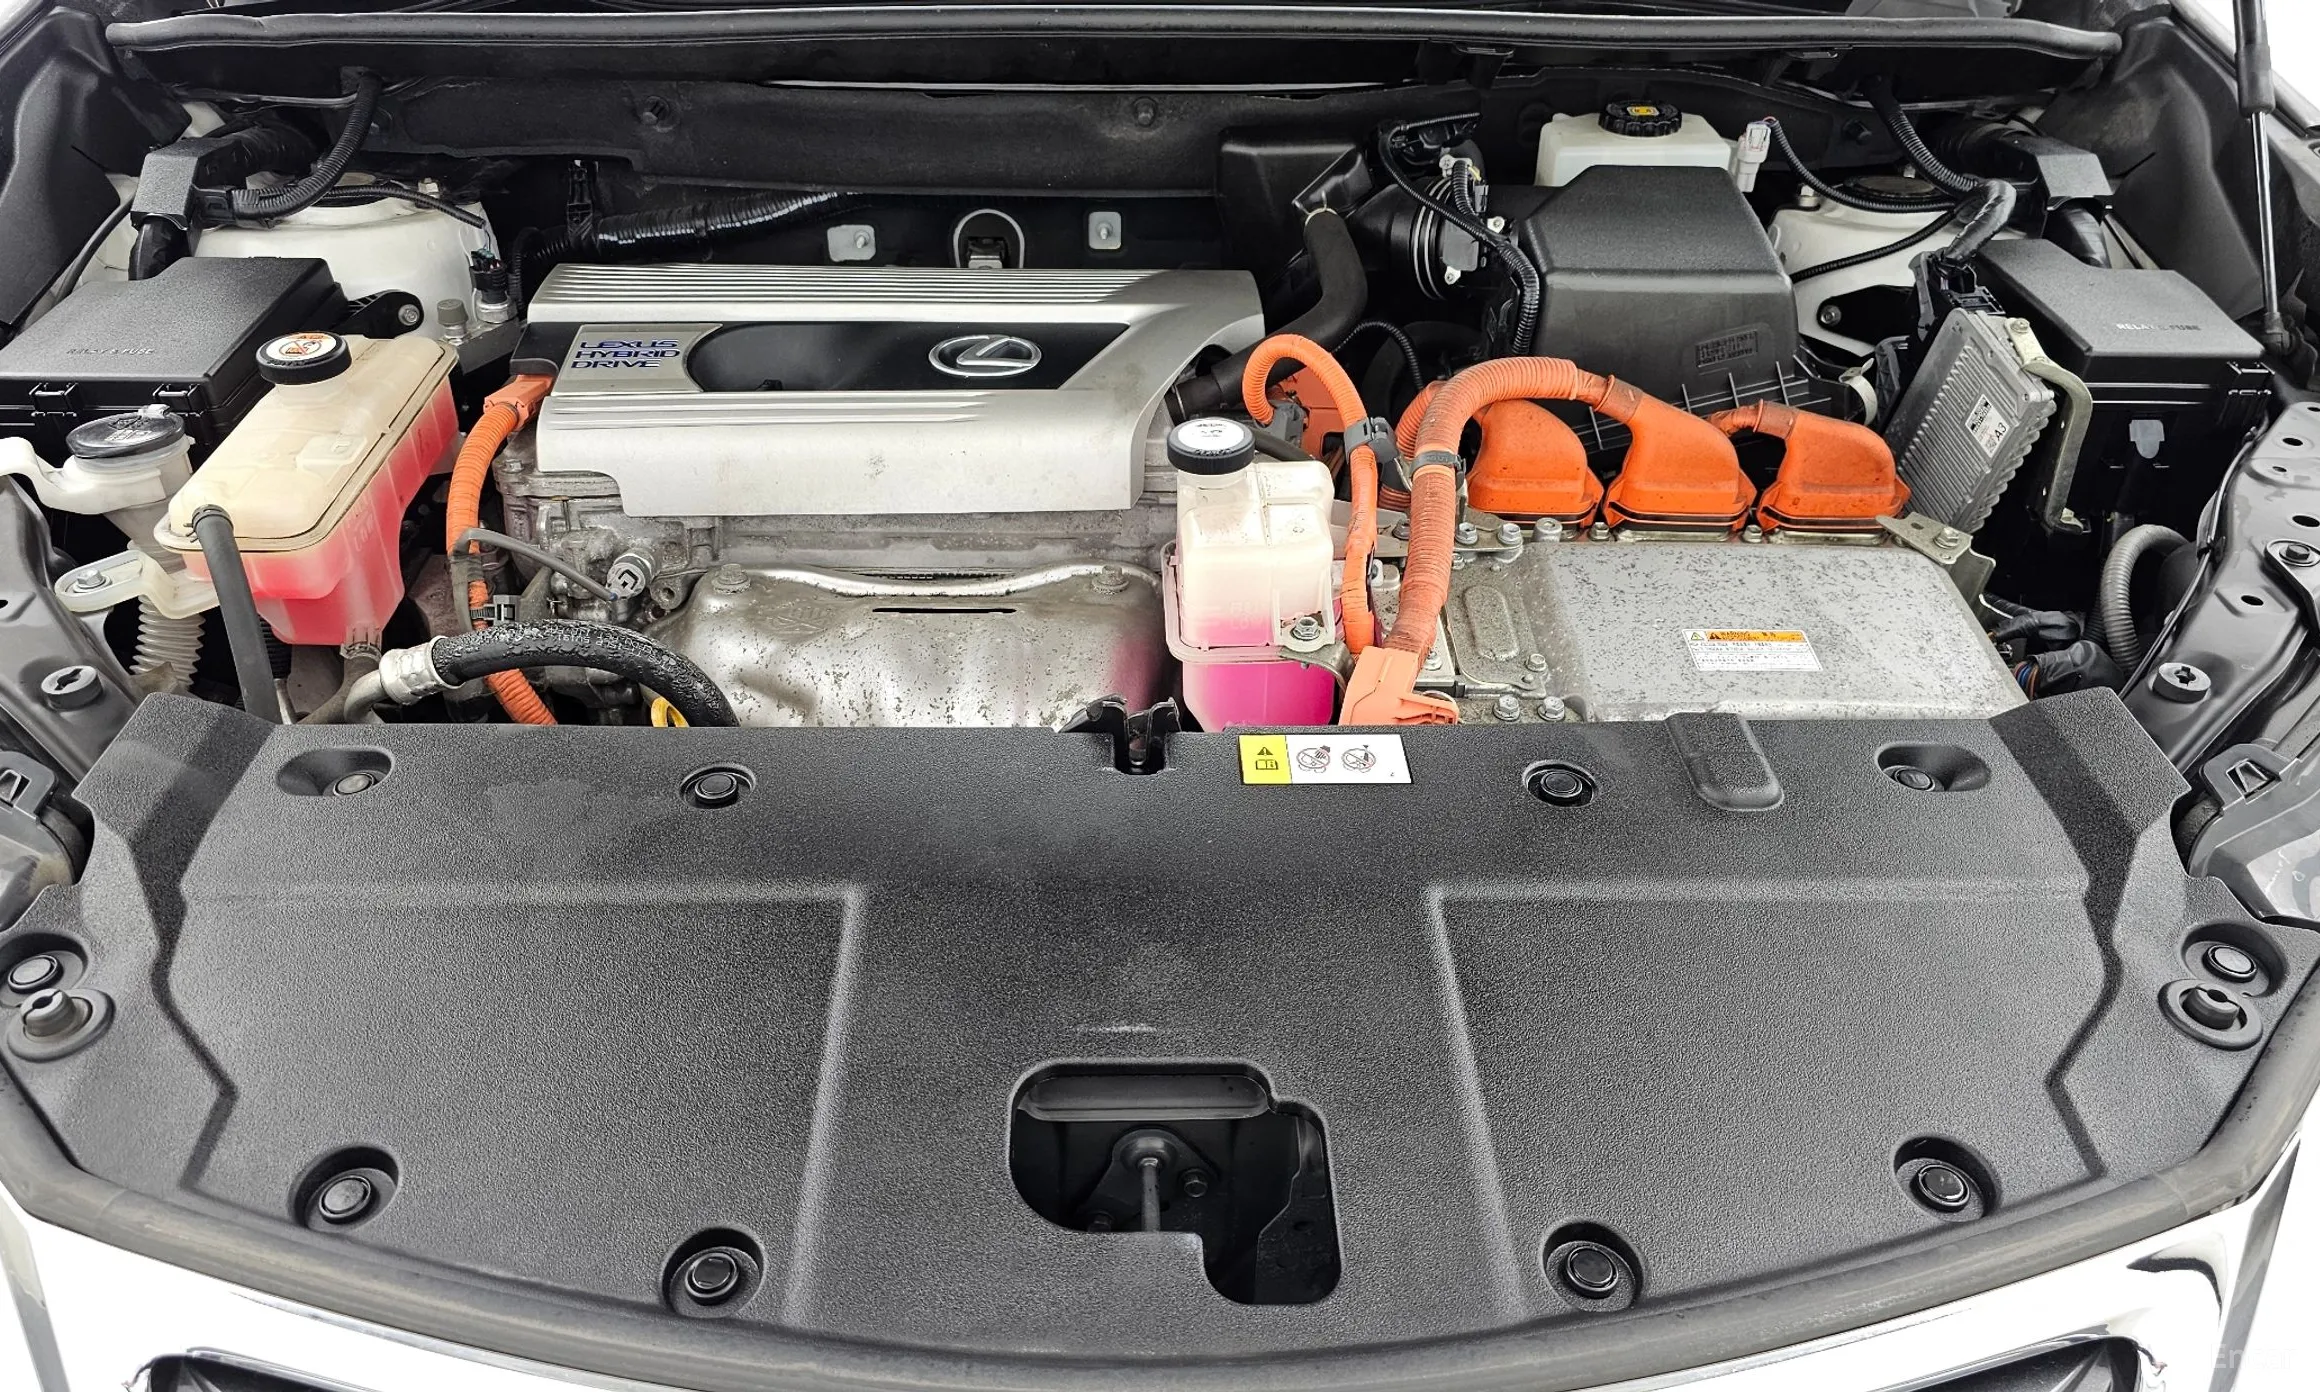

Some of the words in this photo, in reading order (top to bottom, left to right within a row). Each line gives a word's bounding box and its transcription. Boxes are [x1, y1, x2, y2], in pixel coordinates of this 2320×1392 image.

[580, 339, 679, 349] LEXUS
[575, 349, 680, 359] HYBRID
[571, 359, 661, 369] DRIVE
[1994, 421, 2008, 441] A3
